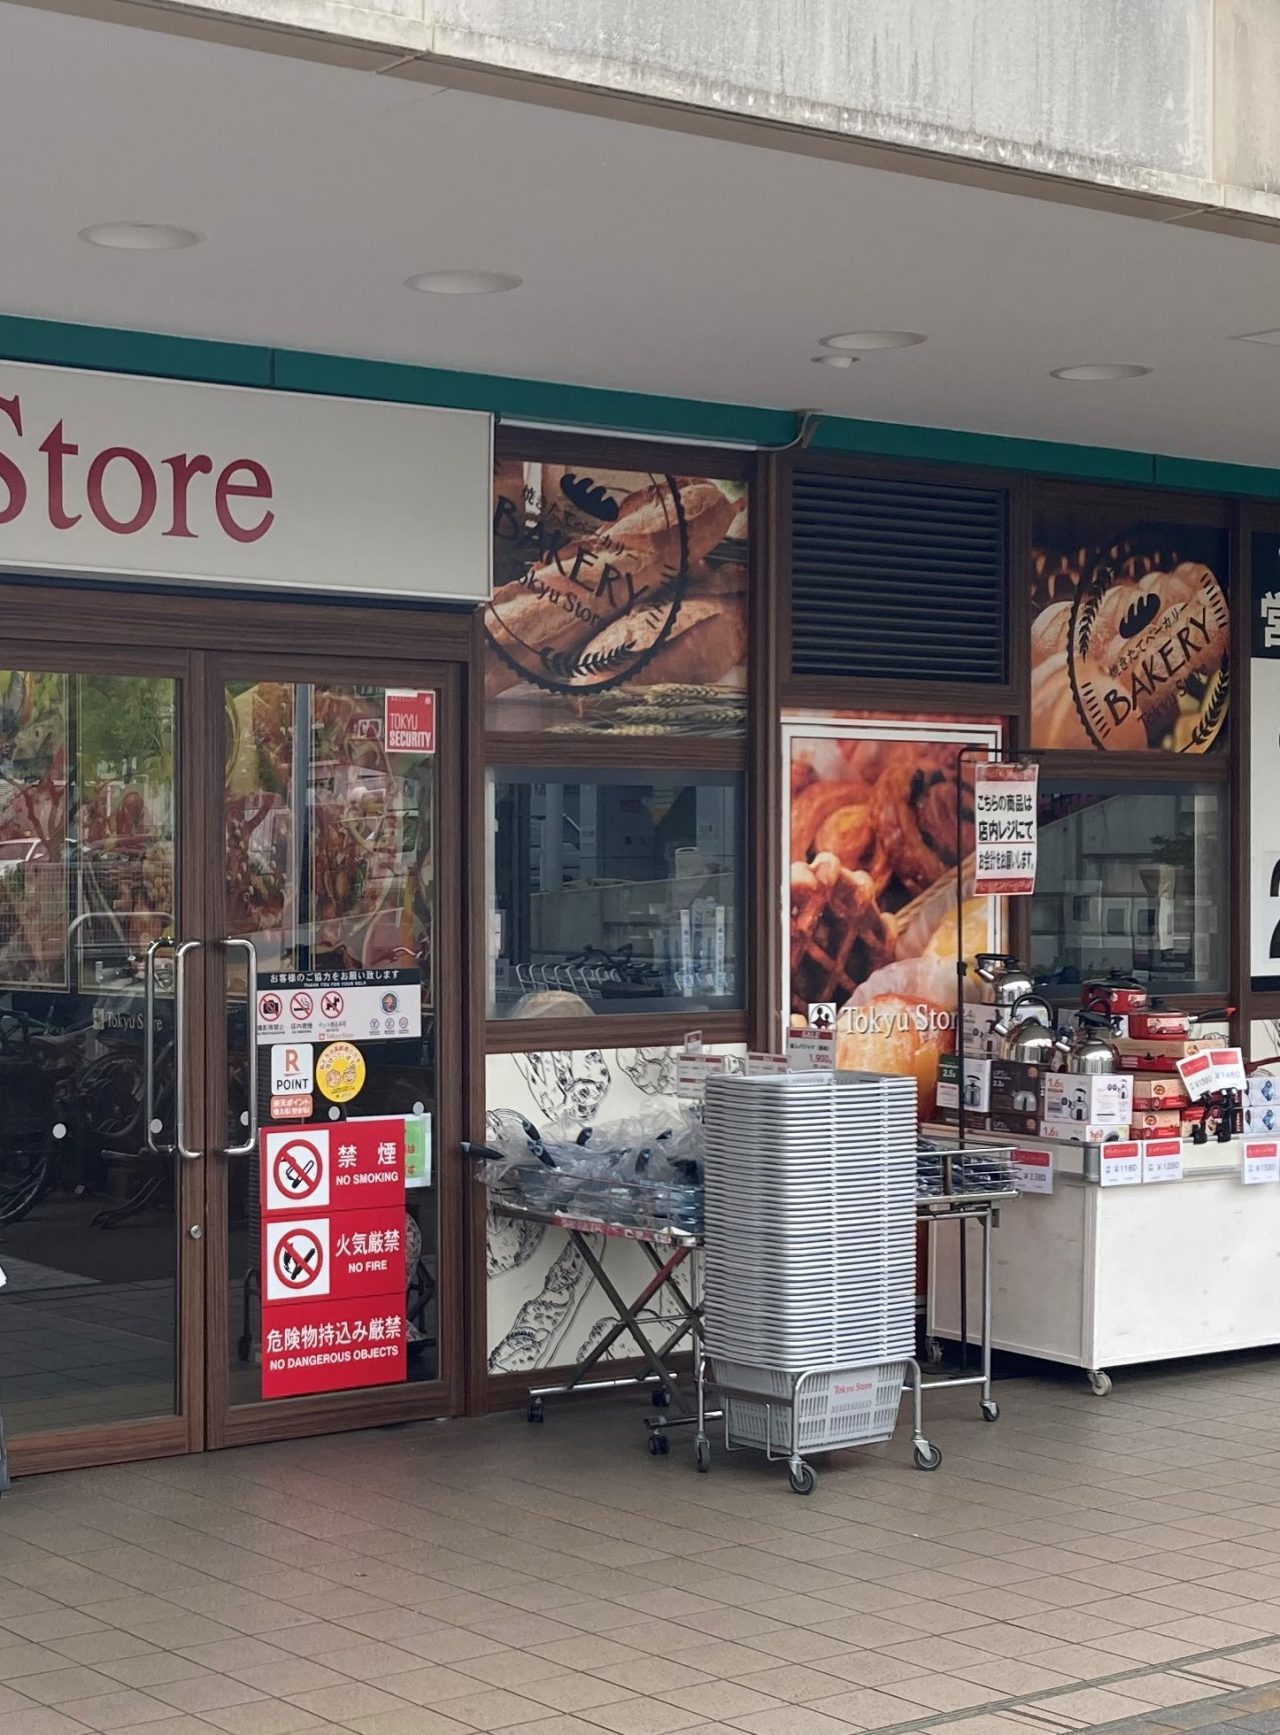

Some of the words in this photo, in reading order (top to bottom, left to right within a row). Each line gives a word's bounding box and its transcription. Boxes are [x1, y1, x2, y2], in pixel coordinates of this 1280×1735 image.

[1104, 607, 1211, 727] BAKERY
[389, 713, 419, 730] TOKYU
[389, 730, 432, 748] SECURITY
[977, 794, 1033, 812] こちらの商品は
[978, 820, 1034, 841] 店内レジにて
[270, 970, 400, 983] お客様のご協力をお願い致します
[106, 1011, 135, 1031] Tokyu
[138, 1013, 163, 1031] Sre
[841, 1005, 910, 1039] Tokyu
[915, 1004, 958, 1031] Stor
[285, 1049, 300, 1072] R
[276, 1079, 309, 1090] POINT
[338, 1142, 397, 1168] 禁煙
[336, 1174, 351, 1185] NO
[353, 1171, 399, 1184] SMOKING
[335, 1229, 400, 1257] 火気厳禁
[348, 1262, 363, 1273] NO
[365, 1259, 387, 1272] FIRE
[266, 1315, 401, 1353] 危険物持込み厳禁
[270, 1358, 285, 1370] NO
[287, 1351, 351, 1369] DANGEROUS
[353, 1344, 399, 1362] OBJECTS
[834, 1385, 854, 1394] Tokyu
[856, 1382, 873, 1391] Store
